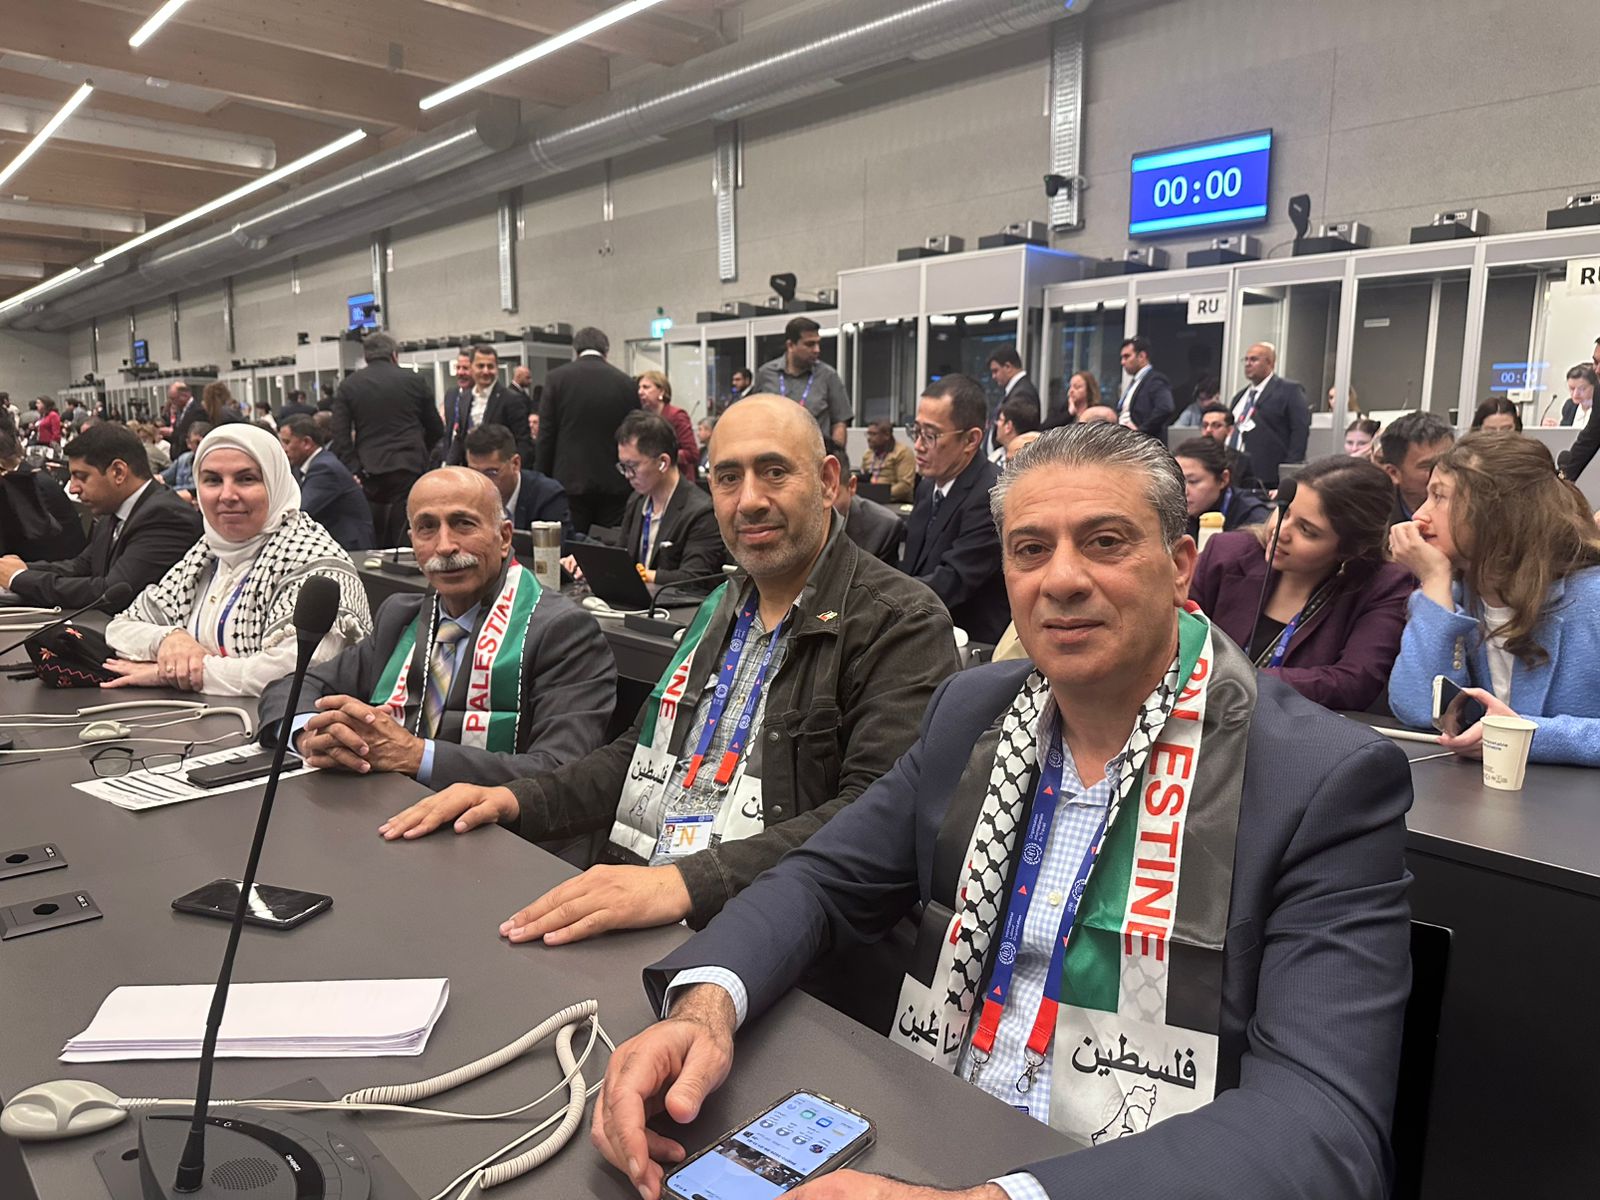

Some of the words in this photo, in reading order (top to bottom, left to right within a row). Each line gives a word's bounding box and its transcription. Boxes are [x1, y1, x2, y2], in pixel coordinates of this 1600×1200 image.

[1153, 167, 1242, 208] 00:00
[1581, 266, 1600, 285] R
[1197, 299, 1219, 315] RU
[680, 826, 696, 846] N
[1072, 1033, 1197, 1089] فلسطين
